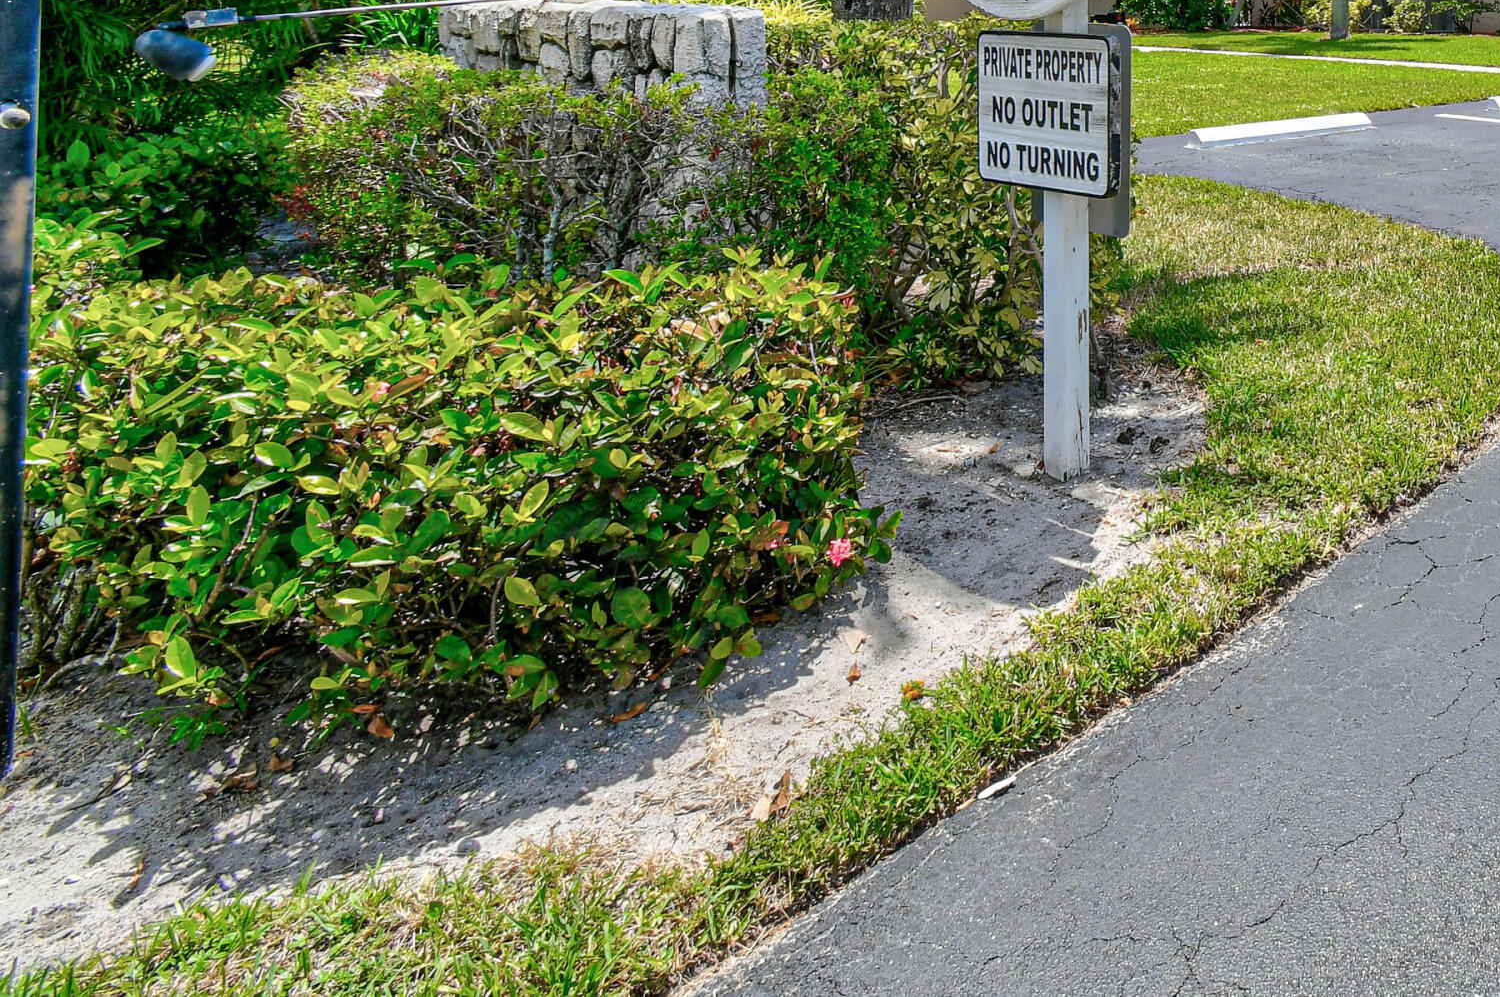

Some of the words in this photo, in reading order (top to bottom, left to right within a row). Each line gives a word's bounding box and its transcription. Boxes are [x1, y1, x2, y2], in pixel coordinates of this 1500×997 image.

[984, 46, 1032, 79] PRIVATE
[1036, 49, 1102, 84] PROPERTY
[992, 96, 1016, 124] NO
[1022, 98, 1093, 133] OUTLET
[987, 140, 1011, 169] NO
[1016, 144, 1099, 181] TURNING
